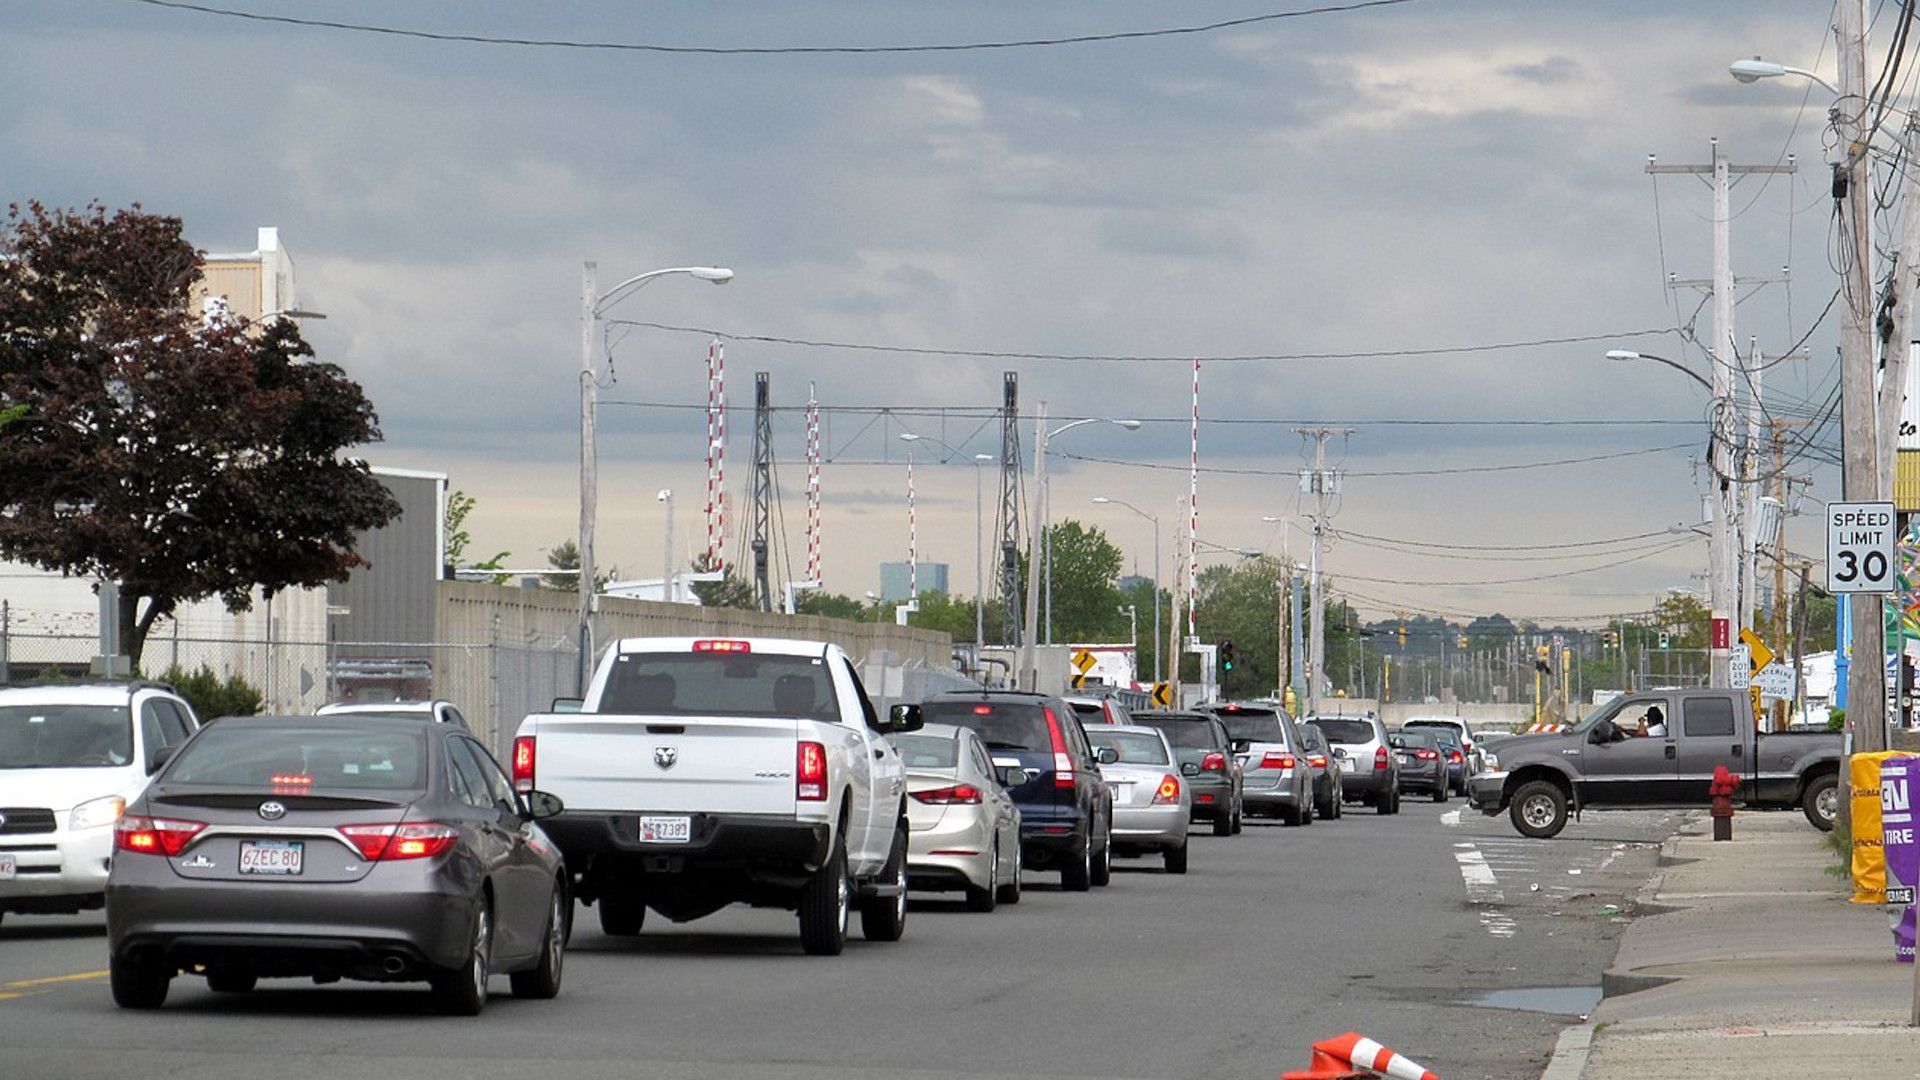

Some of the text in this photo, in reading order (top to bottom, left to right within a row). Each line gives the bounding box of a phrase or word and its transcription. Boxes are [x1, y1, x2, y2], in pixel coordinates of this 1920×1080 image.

[1833, 512, 1891, 527] SPEED
[1839, 531, 1884, 546] LIMIT
[1834, 550, 1889, 583] 30
[1762, 686, 1788, 696] AUGUS
[243, 849, 300, 867] 6ZEC 80
